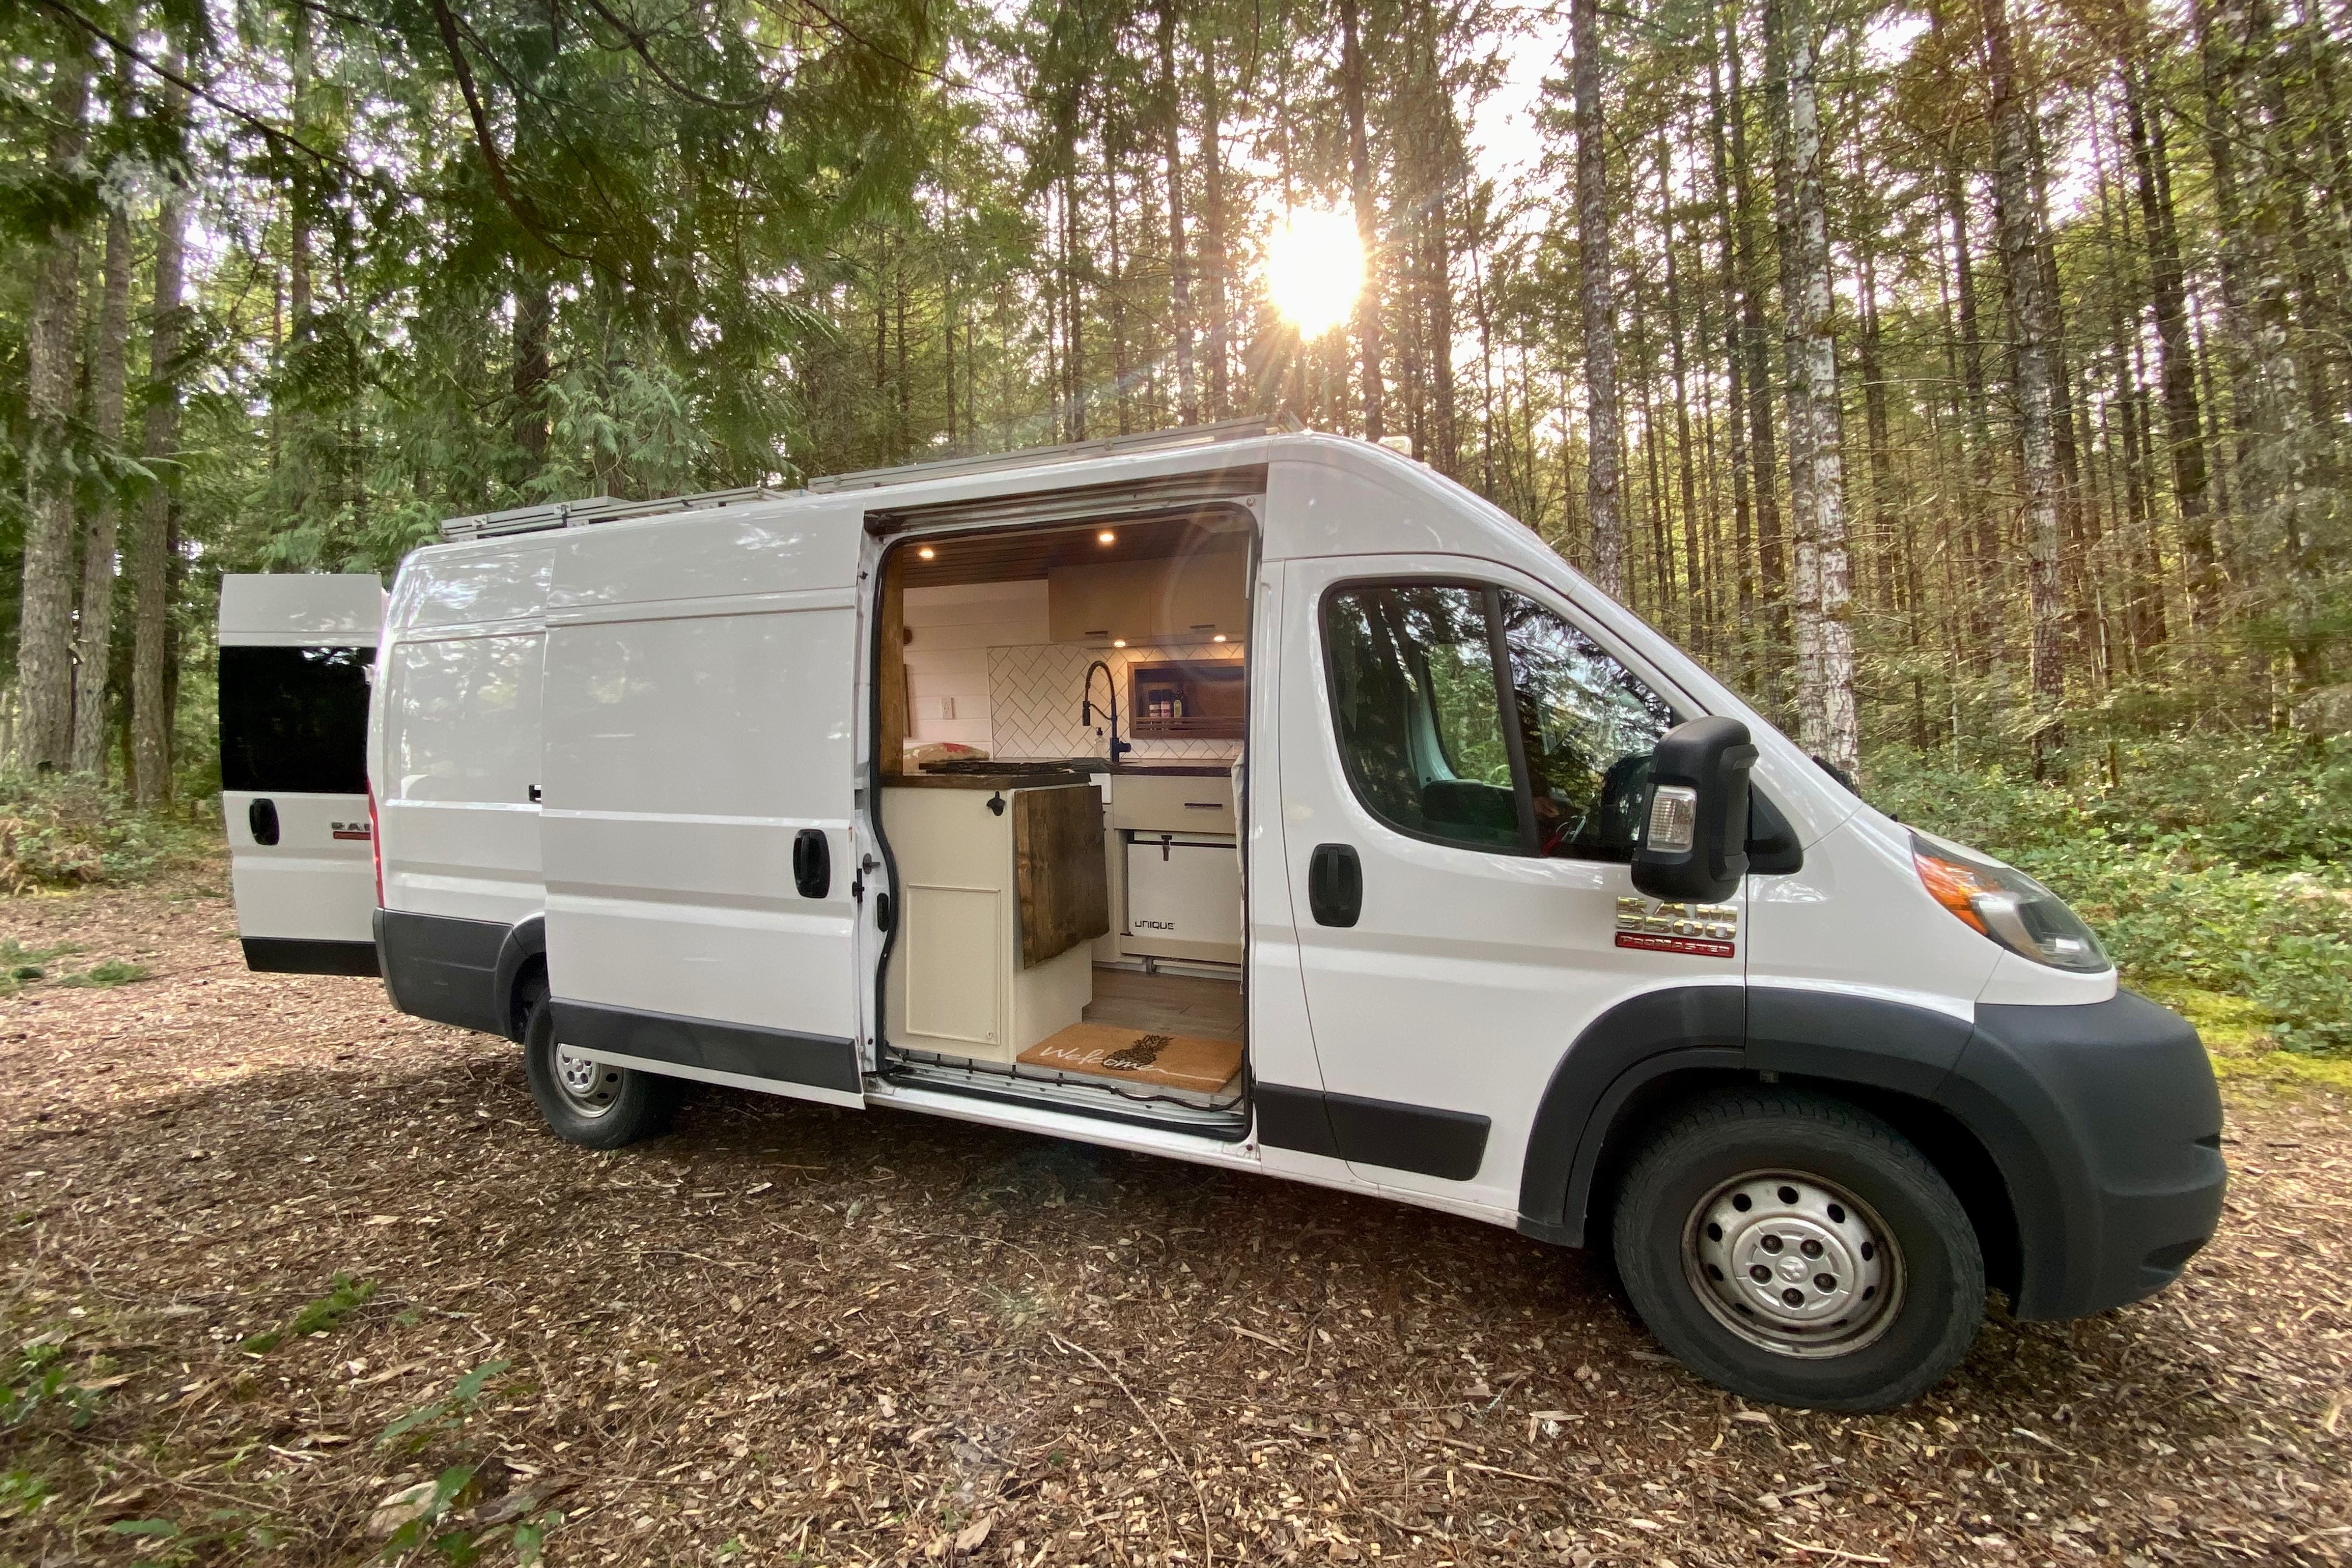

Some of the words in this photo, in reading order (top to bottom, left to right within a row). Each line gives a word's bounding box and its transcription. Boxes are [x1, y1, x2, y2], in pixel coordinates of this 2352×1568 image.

[1616, 897, 1738, 922] RAM
[1135, 921, 1174, 930] UNIQUE
[1615, 914, 1737, 940] 3500
[1620, 935, 1731, 953] PROMASTER
[1039, 1046, 1187, 1075] Welcome
